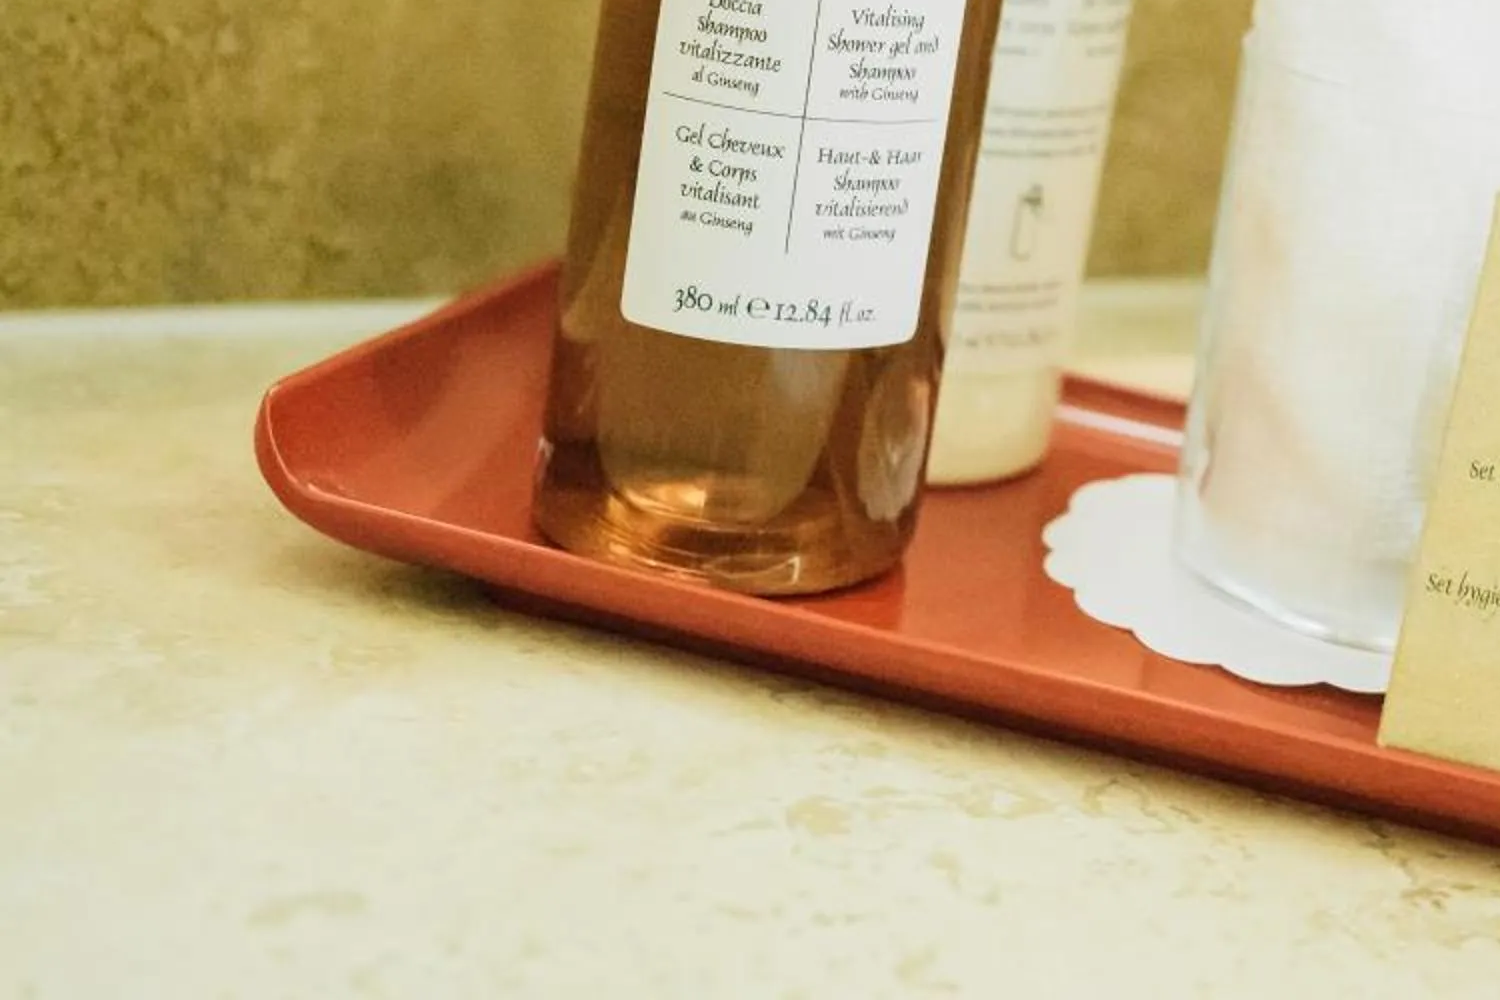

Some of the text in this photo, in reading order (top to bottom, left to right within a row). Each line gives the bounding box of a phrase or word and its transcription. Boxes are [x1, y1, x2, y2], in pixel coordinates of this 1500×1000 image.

[696, 8, 768, 43] Shampoo
[851, 3, 926, 34] Vitalising
[678, 38, 782, 73] vitalizzante
[827, 27, 939, 60] Shower gel and
[691, 65, 760, 98] al Ginseng
[849, 56, 917, 86] Shampoo
[839, 82, 919, 105] with Ginseng
[675, 122, 786, 159] Gel Cheveux
[689, 155, 758, 187] & Corps
[886, 150, 924, 166] Haar
[680, 181, 760, 210] vitalisant
[833, 167, 903, 197] Shampoo
[815, 195, 910, 218] vitalisierend
[680, 209, 754, 237] au Ginseng
[823, 222, 898, 245] mit Ginseng
[673, 285, 714, 313] 380
[718, 294, 741, 317] ml
[773, 299, 832, 328] 12.84
[1469, 459, 1496, 482] Set
[1426, 572, 1453, 597] Set
